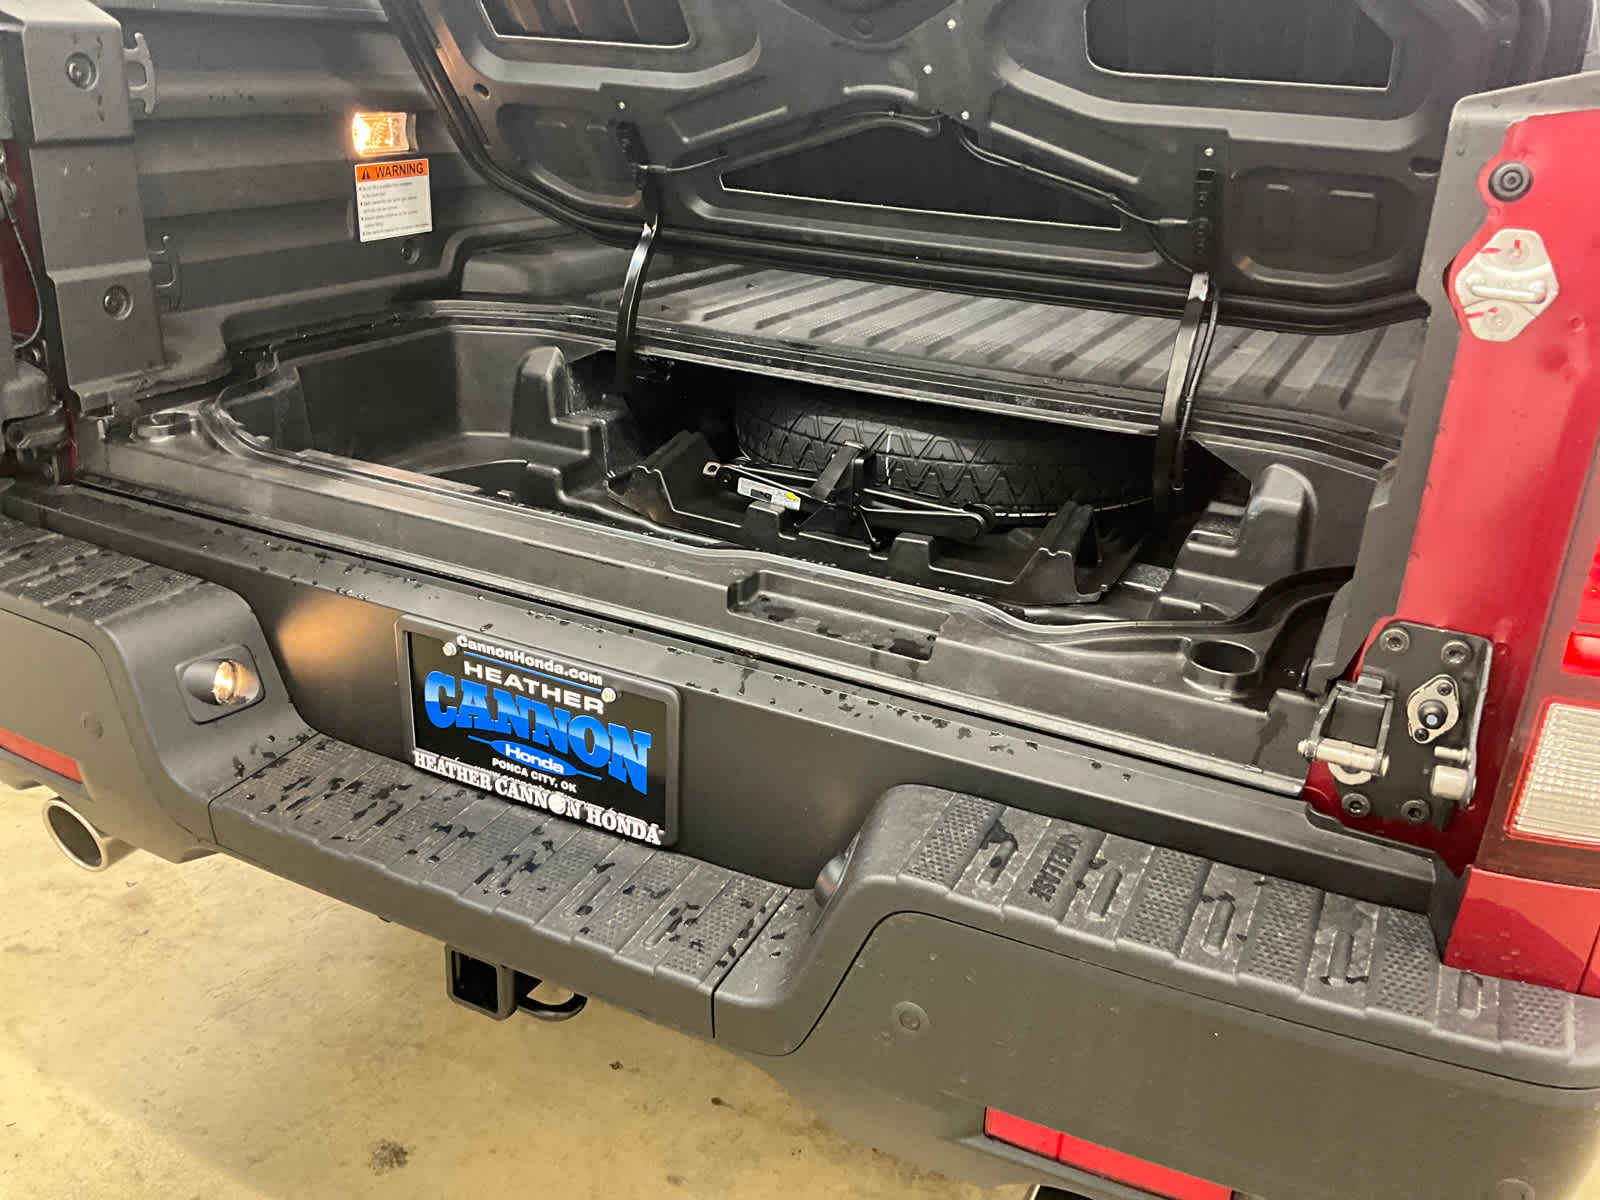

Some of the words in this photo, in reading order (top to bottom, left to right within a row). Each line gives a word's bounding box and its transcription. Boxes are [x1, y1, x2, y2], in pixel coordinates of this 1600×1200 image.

[375, 162, 424, 178] WARNING
[456, 635, 603, 686] CannonHonda.com
[463, 660, 604, 715] HEATHER
[424, 670, 652, 795] CANNON
[491, 757, 529, 777] PONCA
[530, 770, 558, 789] CITY,
[560, 779, 577, 794] OK
[505, 743, 565, 774] Honda
[412, 750, 493, 791] HEATHER
[585, 806, 662, 846] HONDA
